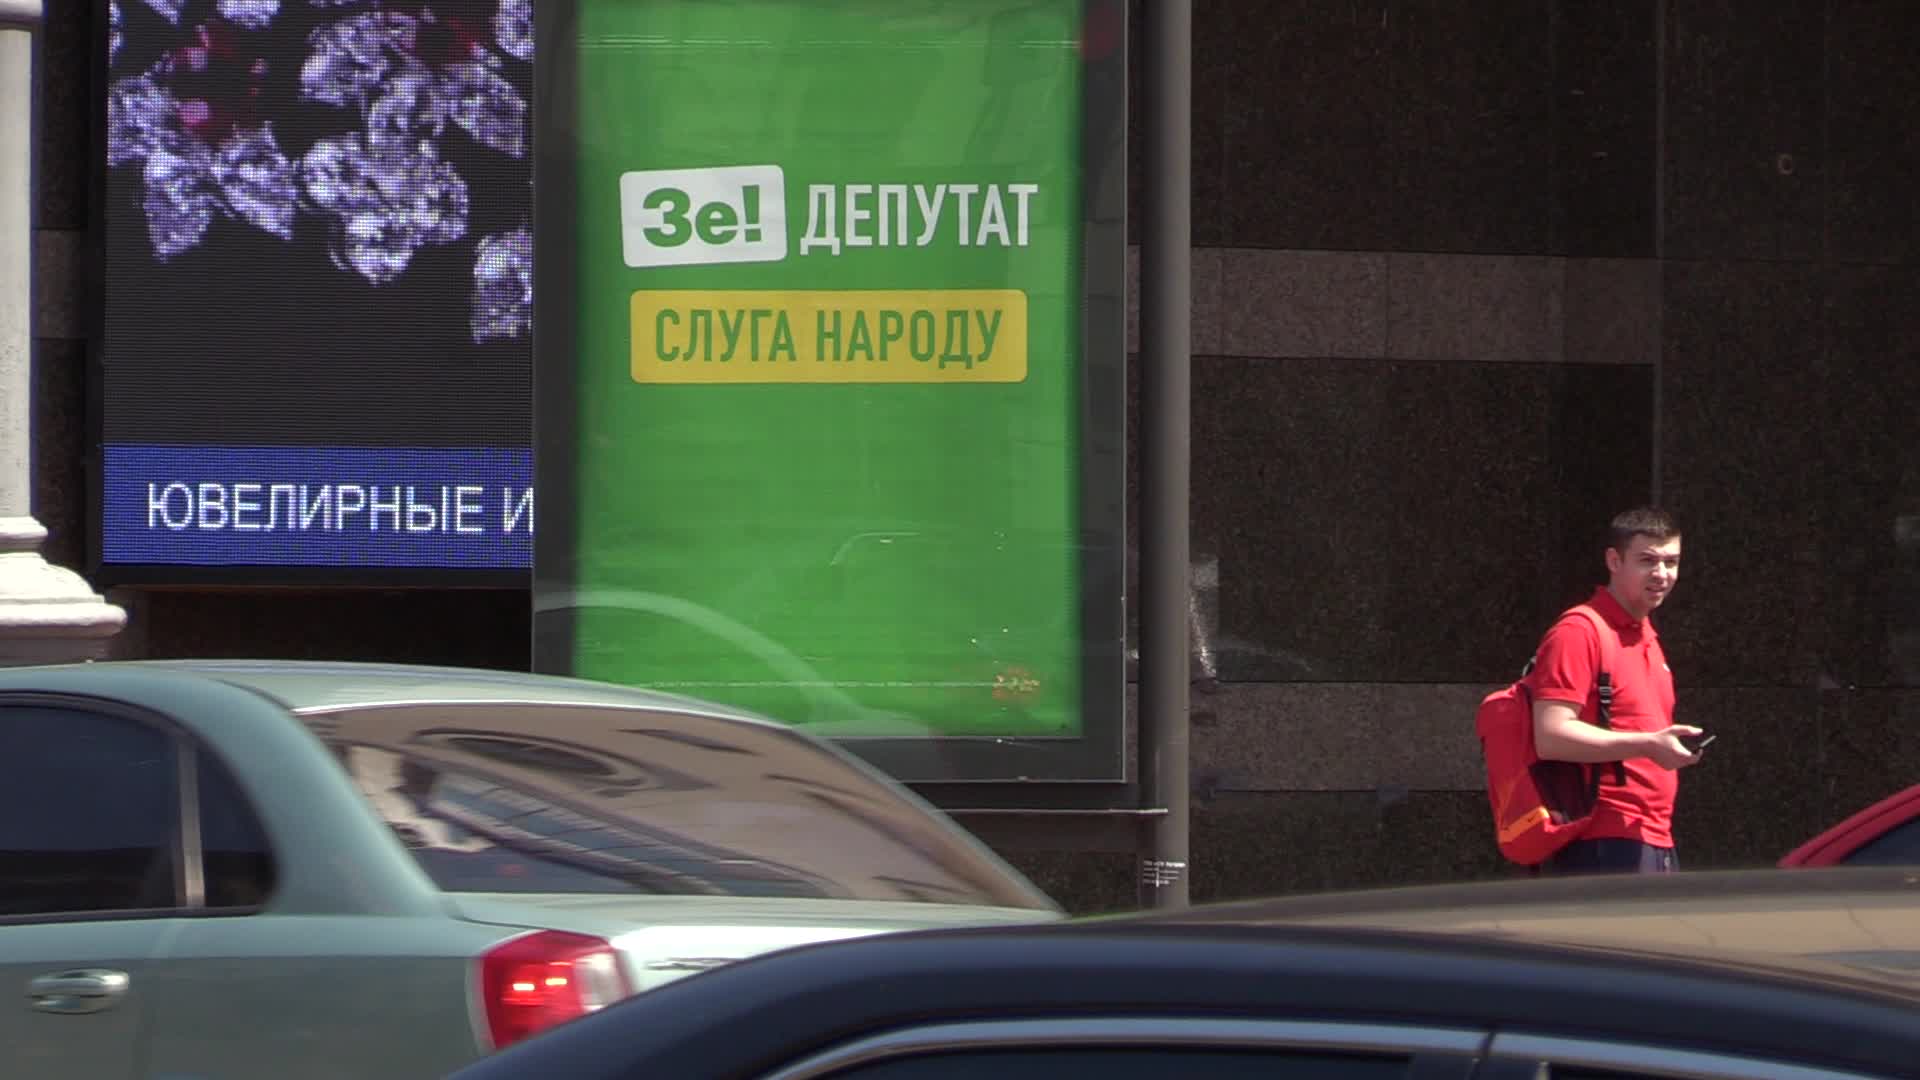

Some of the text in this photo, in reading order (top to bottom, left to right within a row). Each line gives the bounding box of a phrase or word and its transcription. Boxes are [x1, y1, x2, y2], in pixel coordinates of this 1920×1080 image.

[642, 183, 1039, 256] Зе! ДЕПУТАТ
[655, 308, 1004, 370] СЛУГА НАРОДУ
[147, 482, 484, 534] ЮВЕЛИРНЫЕ
